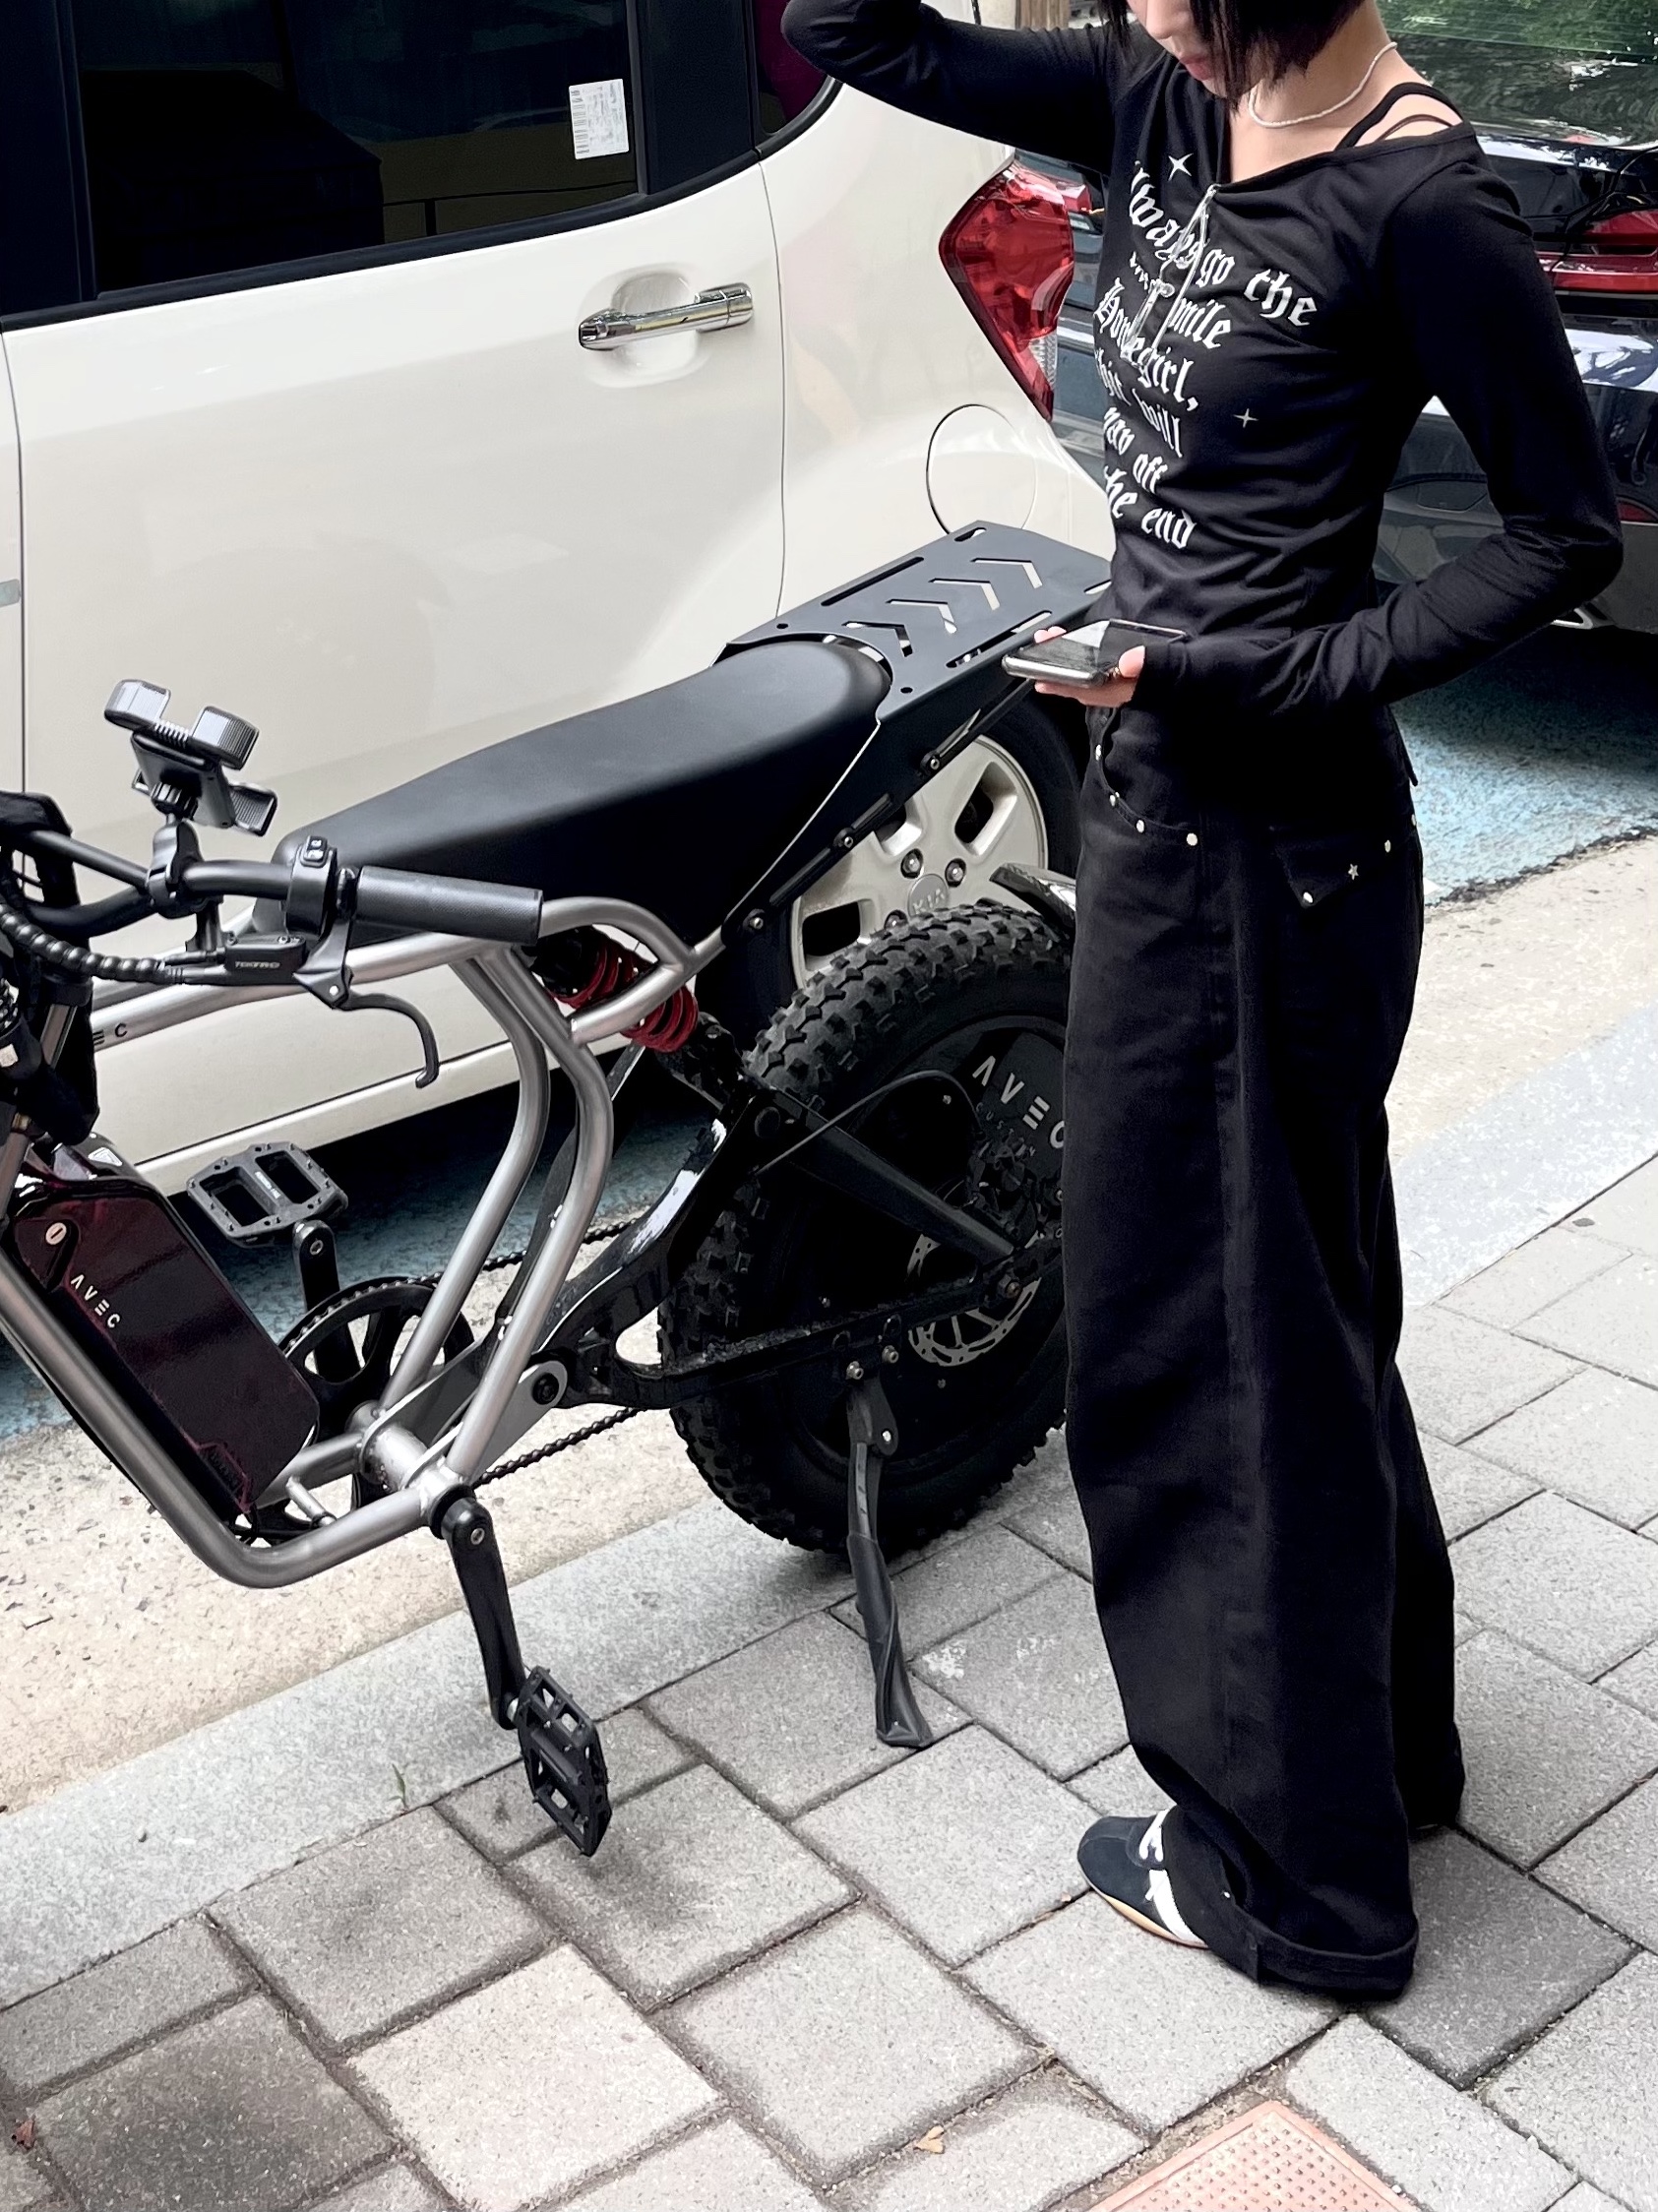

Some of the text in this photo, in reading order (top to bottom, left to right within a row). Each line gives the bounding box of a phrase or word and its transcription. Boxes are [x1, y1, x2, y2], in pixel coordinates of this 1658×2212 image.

[1195, 248, 1236, 288] go
[1243, 268, 1318, 327] the
[1167, 297, 1232, 349] mile
[1132, 388, 1184, 459] will
[1133, 453, 1169, 494] off
[1140, 507, 1197, 549] end
[70, 1273, 121, 1328] AVEC
